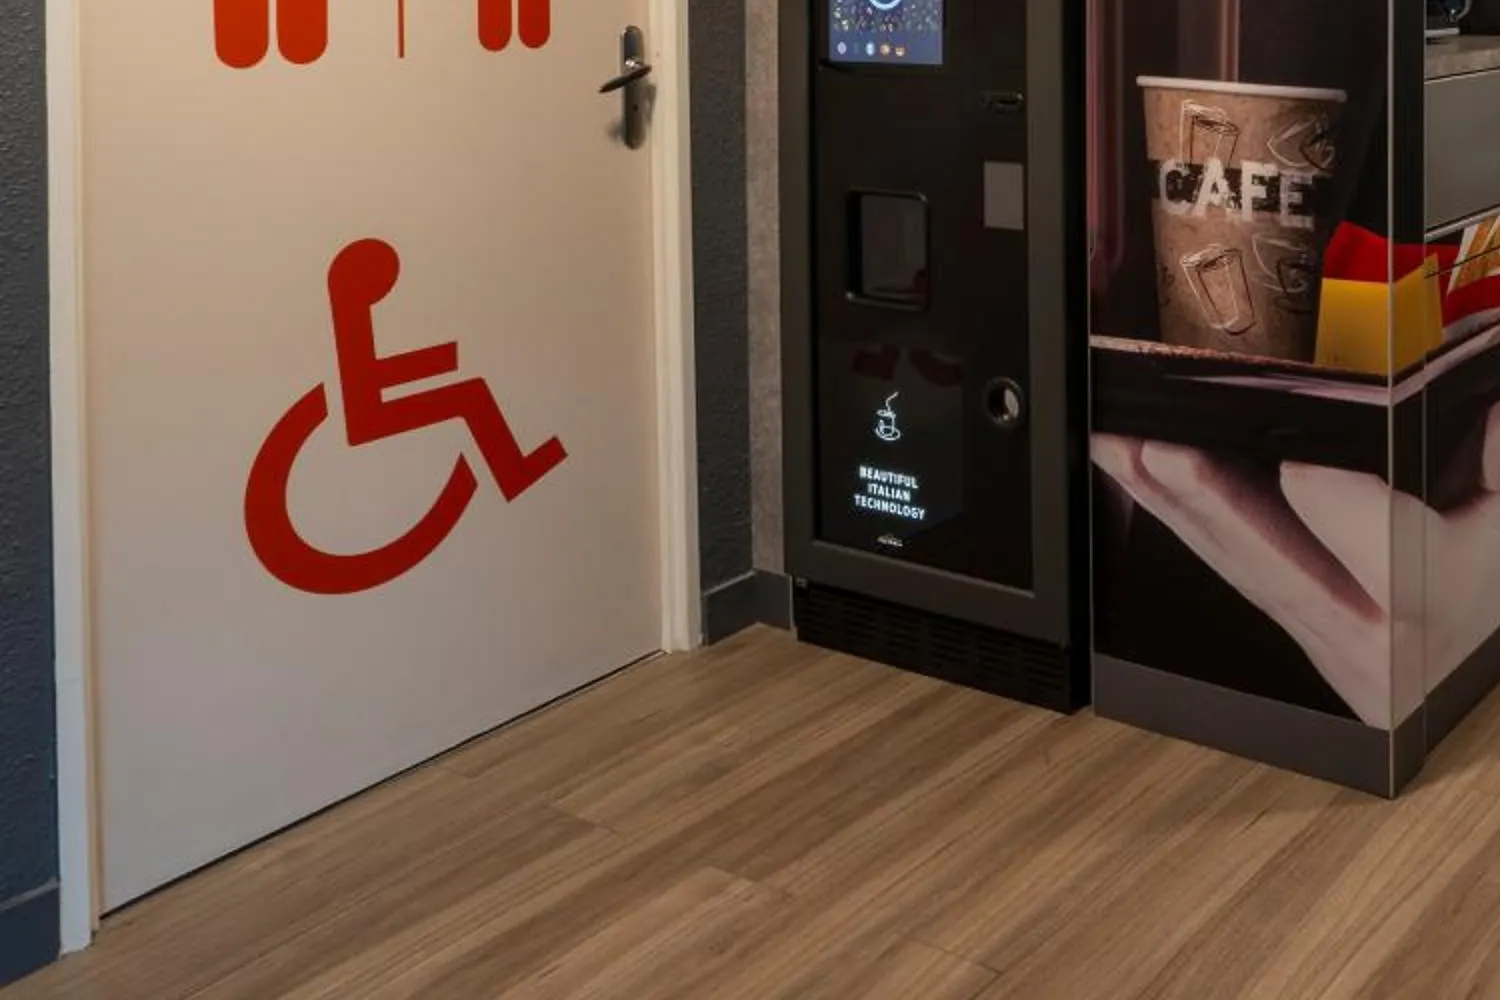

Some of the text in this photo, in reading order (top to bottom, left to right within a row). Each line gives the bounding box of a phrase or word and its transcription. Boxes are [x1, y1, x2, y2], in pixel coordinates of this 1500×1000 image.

[1158, 156, 1316, 230] CAFE
[858, 465, 919, 489] BEAUTIFUL
[867, 482, 912, 502] ITALIAN
[853, 493, 926, 521] TECHNOLOGY
